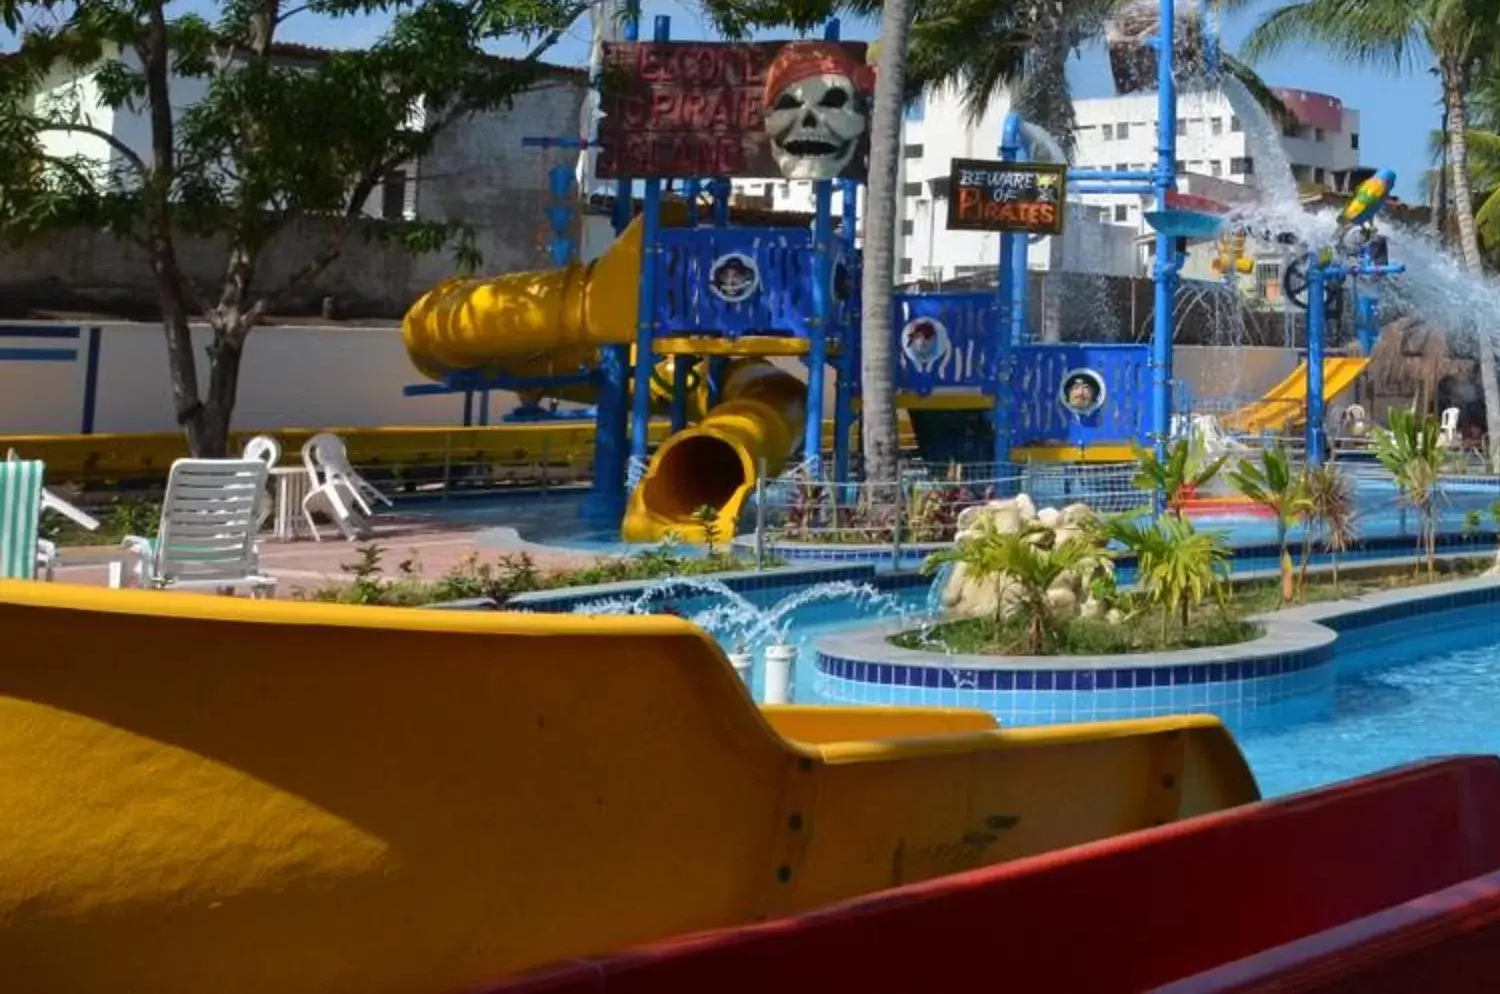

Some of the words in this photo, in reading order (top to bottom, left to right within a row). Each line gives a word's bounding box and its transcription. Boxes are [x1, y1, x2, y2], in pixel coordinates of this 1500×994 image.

[650, 90, 764, 129] PIRATE
[959, 169, 1035, 189] BEWARE
[958, 188, 1054, 223] PIRATES
[993, 189, 1018, 203] OF
